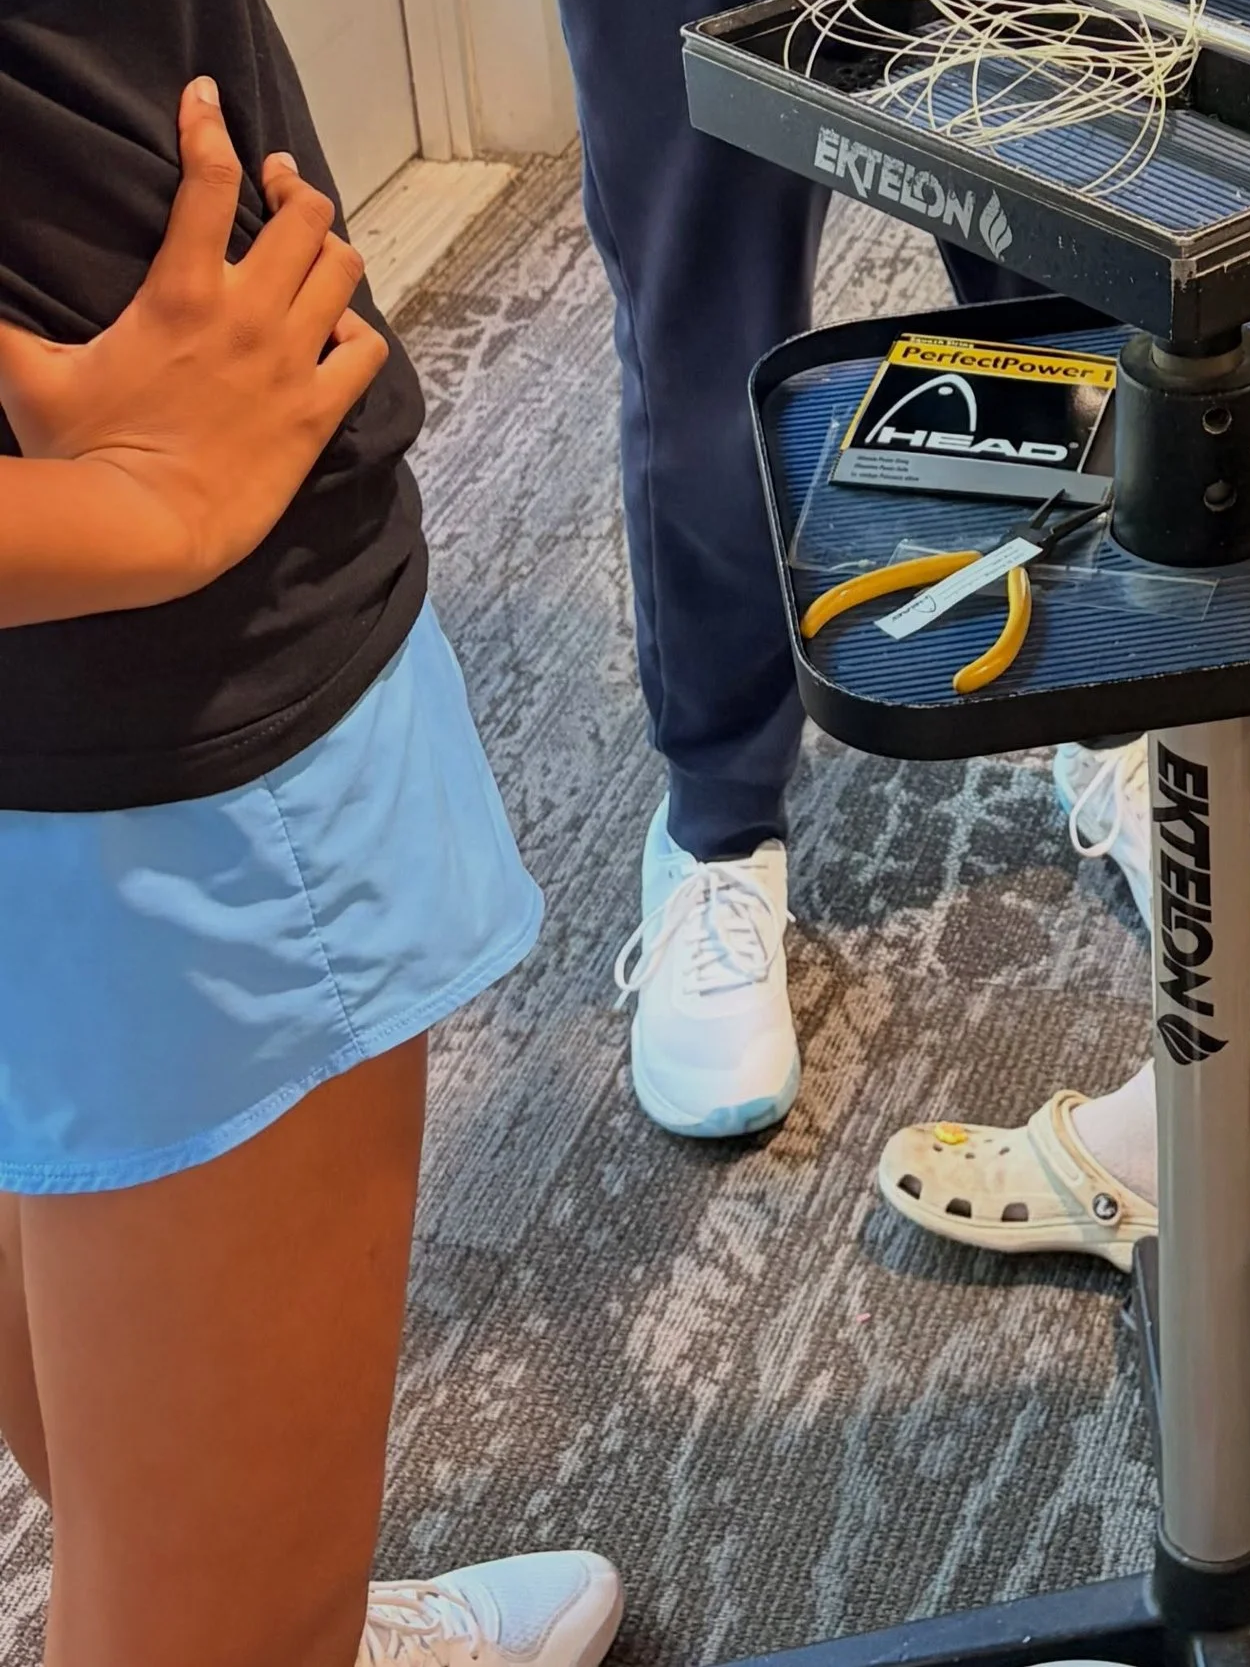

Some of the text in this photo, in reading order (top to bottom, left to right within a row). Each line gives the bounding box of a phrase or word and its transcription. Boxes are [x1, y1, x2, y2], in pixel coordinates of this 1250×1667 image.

[813, 125, 976, 240] EKTELON
[901, 346, 1095, 378] PerfectPower
[876, 426, 1069, 462] HEAD
[1152, 740, 1215, 1018] EKTELON
